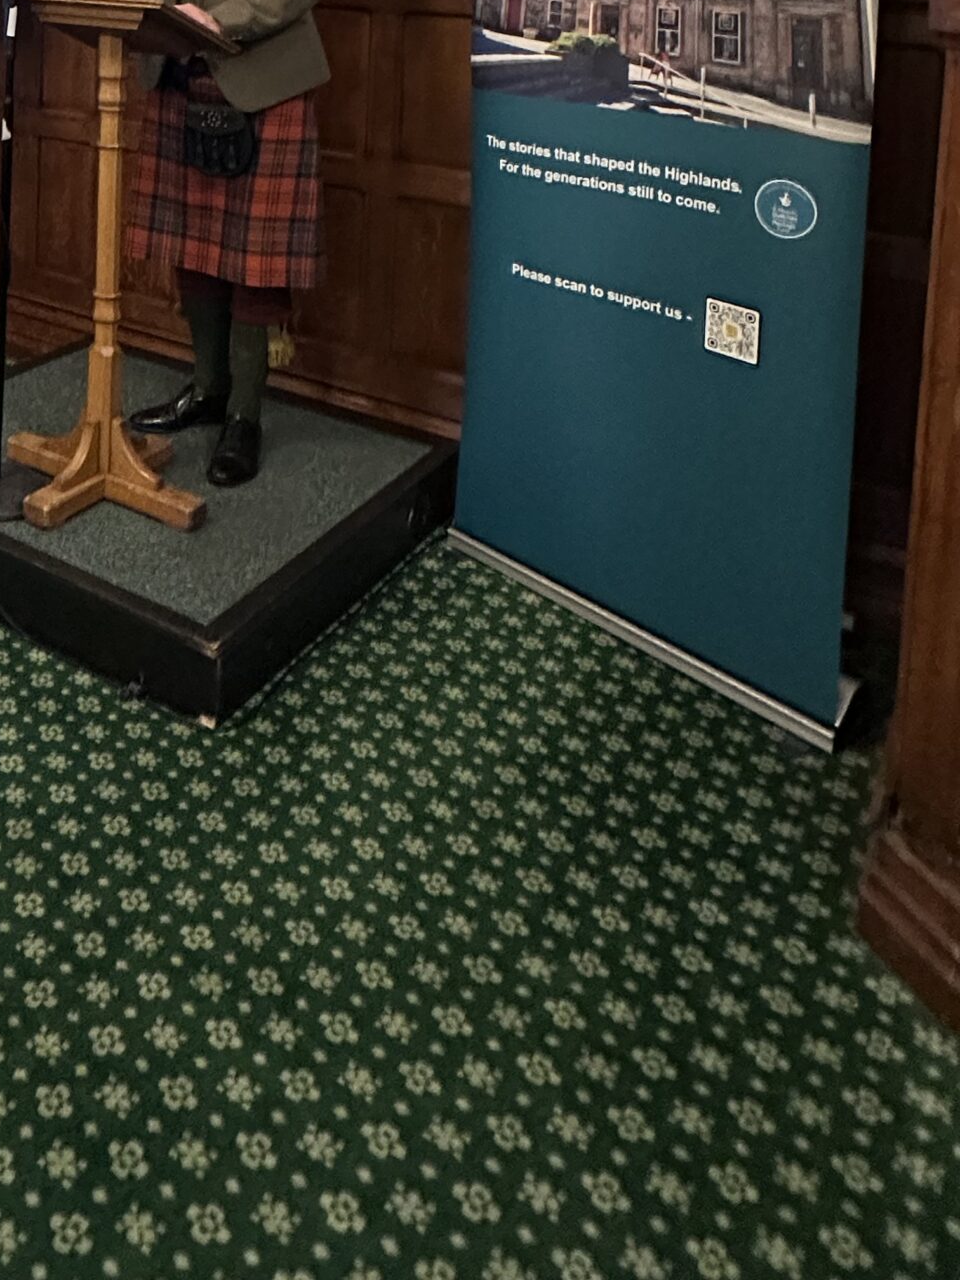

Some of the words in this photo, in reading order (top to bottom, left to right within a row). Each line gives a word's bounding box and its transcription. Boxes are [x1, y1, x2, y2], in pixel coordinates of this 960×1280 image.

[486, 134, 506, 150] The
[509, 141, 551, 158] stories
[554, 147, 580, 163] that
[583, 153, 635, 173] shaped
[638, 161, 661, 177] the
[664, 165, 742, 194] Highlands.
[499, 158, 519, 174] For
[521, 163, 541, 178] the
[544, 170, 625, 194] generations
[628, 185, 654, 200] still
[657, 189, 672, 204] to
[675, 195, 721, 215] come.
[511, 263, 552, 285] Please
[554, 276, 587, 294] scan
[589, 284, 604, 298] to
[607, 290, 662, 315] support
[665, 306, 683, 321] us
